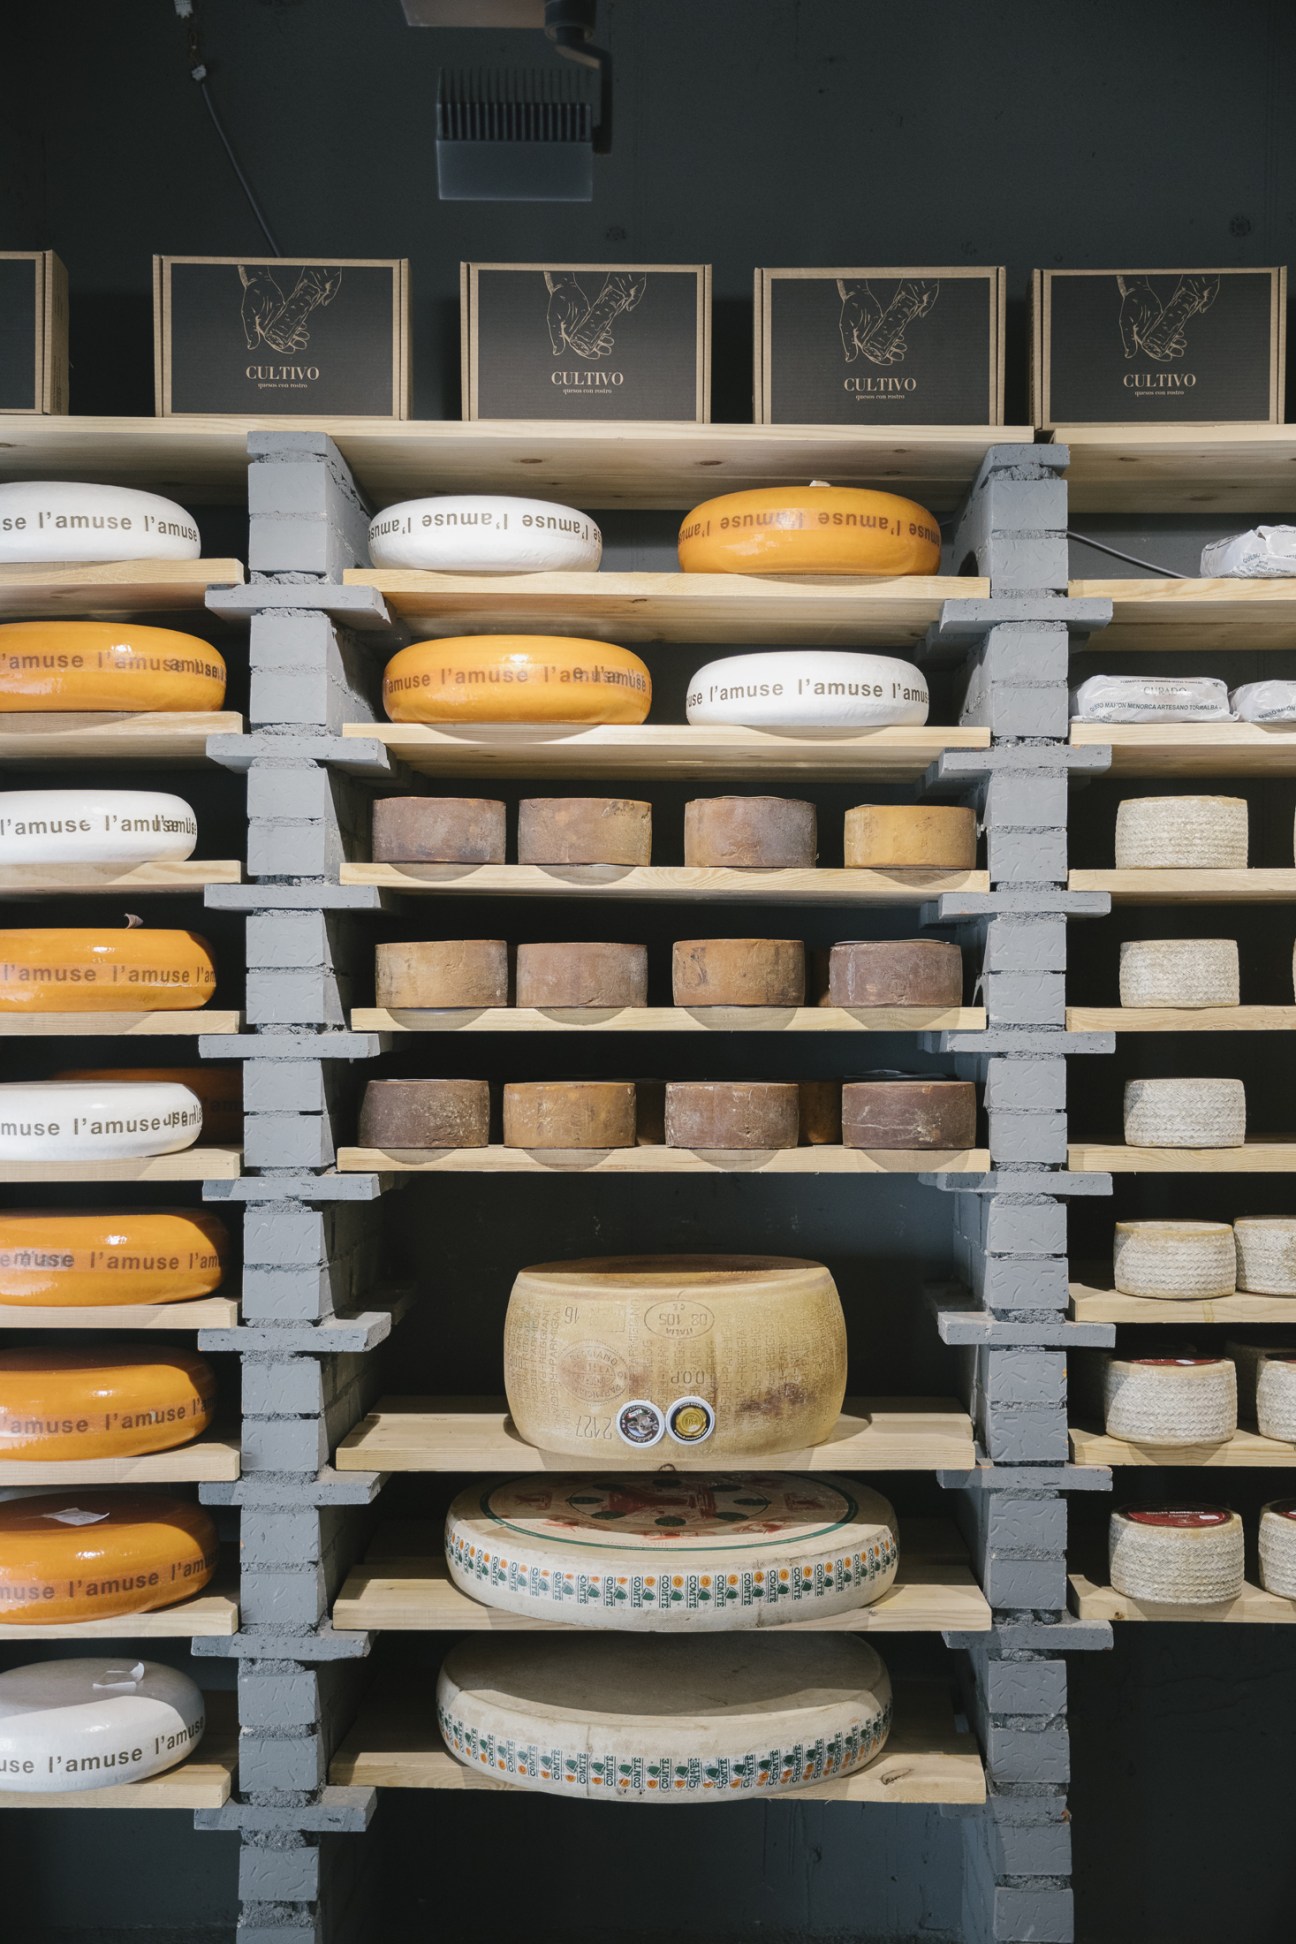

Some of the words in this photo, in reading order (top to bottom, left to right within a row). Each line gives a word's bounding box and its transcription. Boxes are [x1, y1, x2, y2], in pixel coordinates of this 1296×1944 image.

[246, 366, 320, 380] CULTIVO
[552, 372, 624, 386] CULTIVO
[1123, 374, 1196, 387] CULTIVO
[844, 378, 916, 391] CULTIVO
[39, 512, 132, 530] l'amuse
[144, 515, 198, 542] l'amuse
[422, 512, 508, 530] l'amuse
[522, 514, 588, 540] l'amuse
[818, 512, 900, 536] l'amuse
[441, 668, 528, 684] l'amuse
[710, 685, 784, 702] l'amuse
[798, 679, 883, 698] l'amuse
[0, 818, 91, 835] l'amuse
[4, 964, 96, 982] l'amuse
[113, 965, 190, 983] l'amuse
[73, 1118, 161, 1135] l'amuse
[90, 1252, 179, 1270] l'amuse
[666, 1327, 693, 1336] ITALIA
[104, 1406, 186, 1431] l'amuse
[69, 1572, 159, 1598] l'amuse
[49, 1747, 143, 1773] l'amuse
